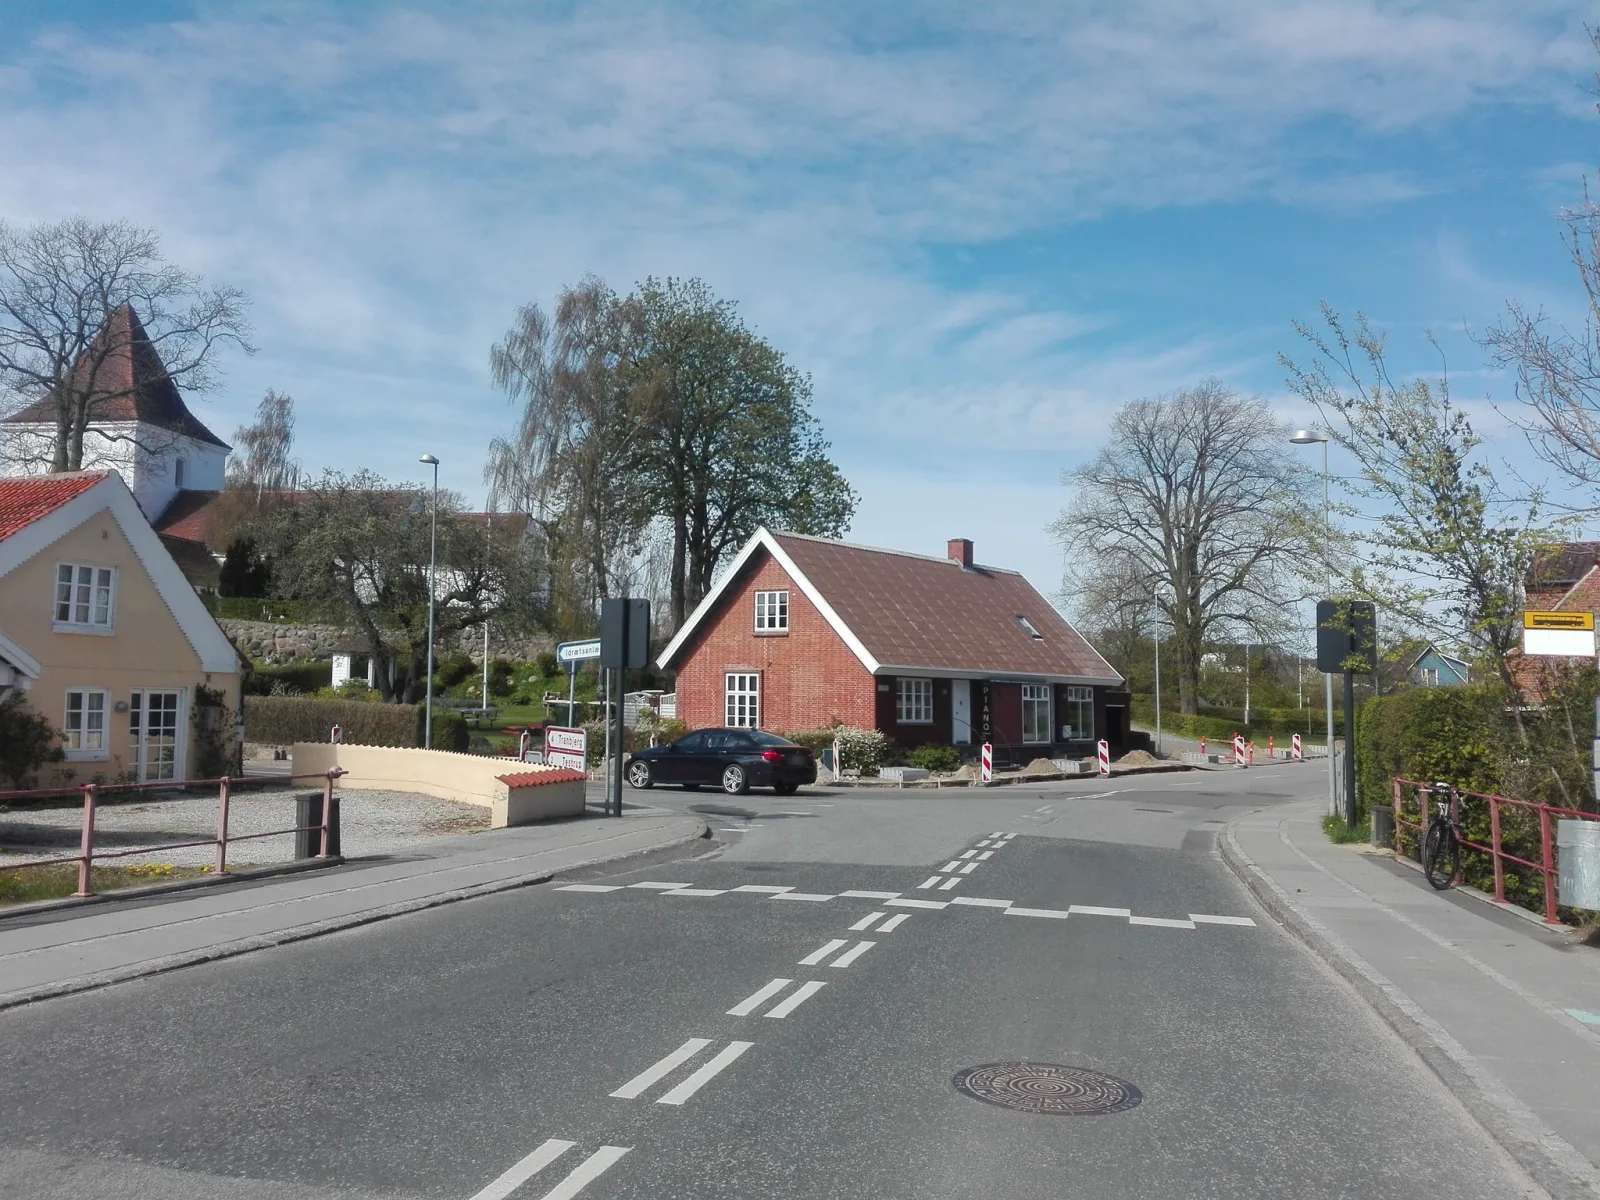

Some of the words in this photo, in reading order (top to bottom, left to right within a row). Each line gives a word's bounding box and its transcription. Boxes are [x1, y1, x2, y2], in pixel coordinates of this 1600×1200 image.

[565, 646, 600, 657] Idrætsanlæ
[982, 686, 990, 731] PIANO
[559, 734, 583, 749] Tranbjerg
[562, 756, 582, 769] Testrup
